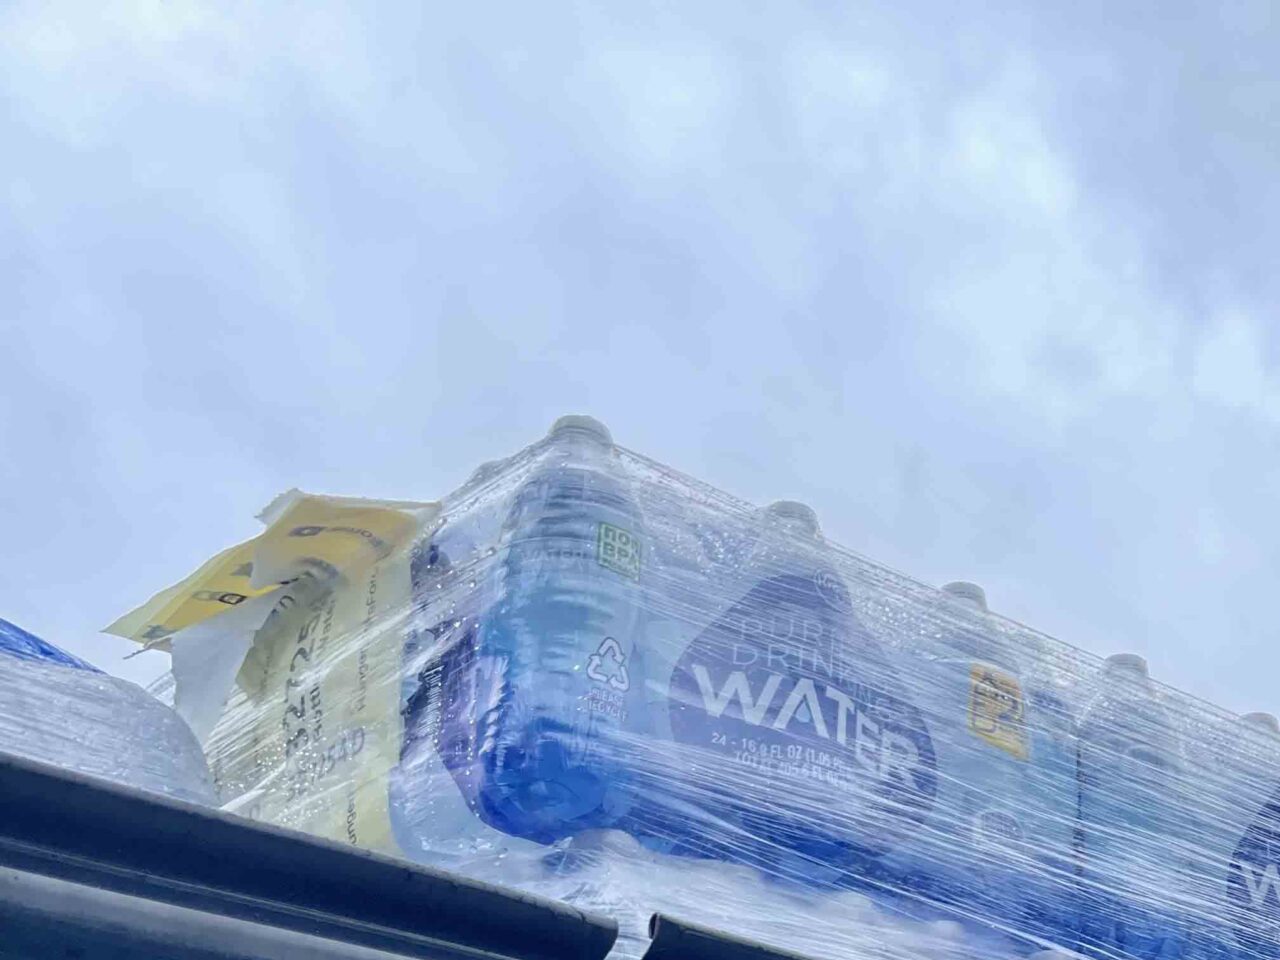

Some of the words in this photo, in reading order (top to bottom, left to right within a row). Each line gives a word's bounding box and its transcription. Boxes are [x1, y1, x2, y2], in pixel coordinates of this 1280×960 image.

[691, 663, 927, 790] WATER
[711, 732, 726, 746] 24
[770, 744, 784, 758] FL
[787, 745, 802, 759] OZ
